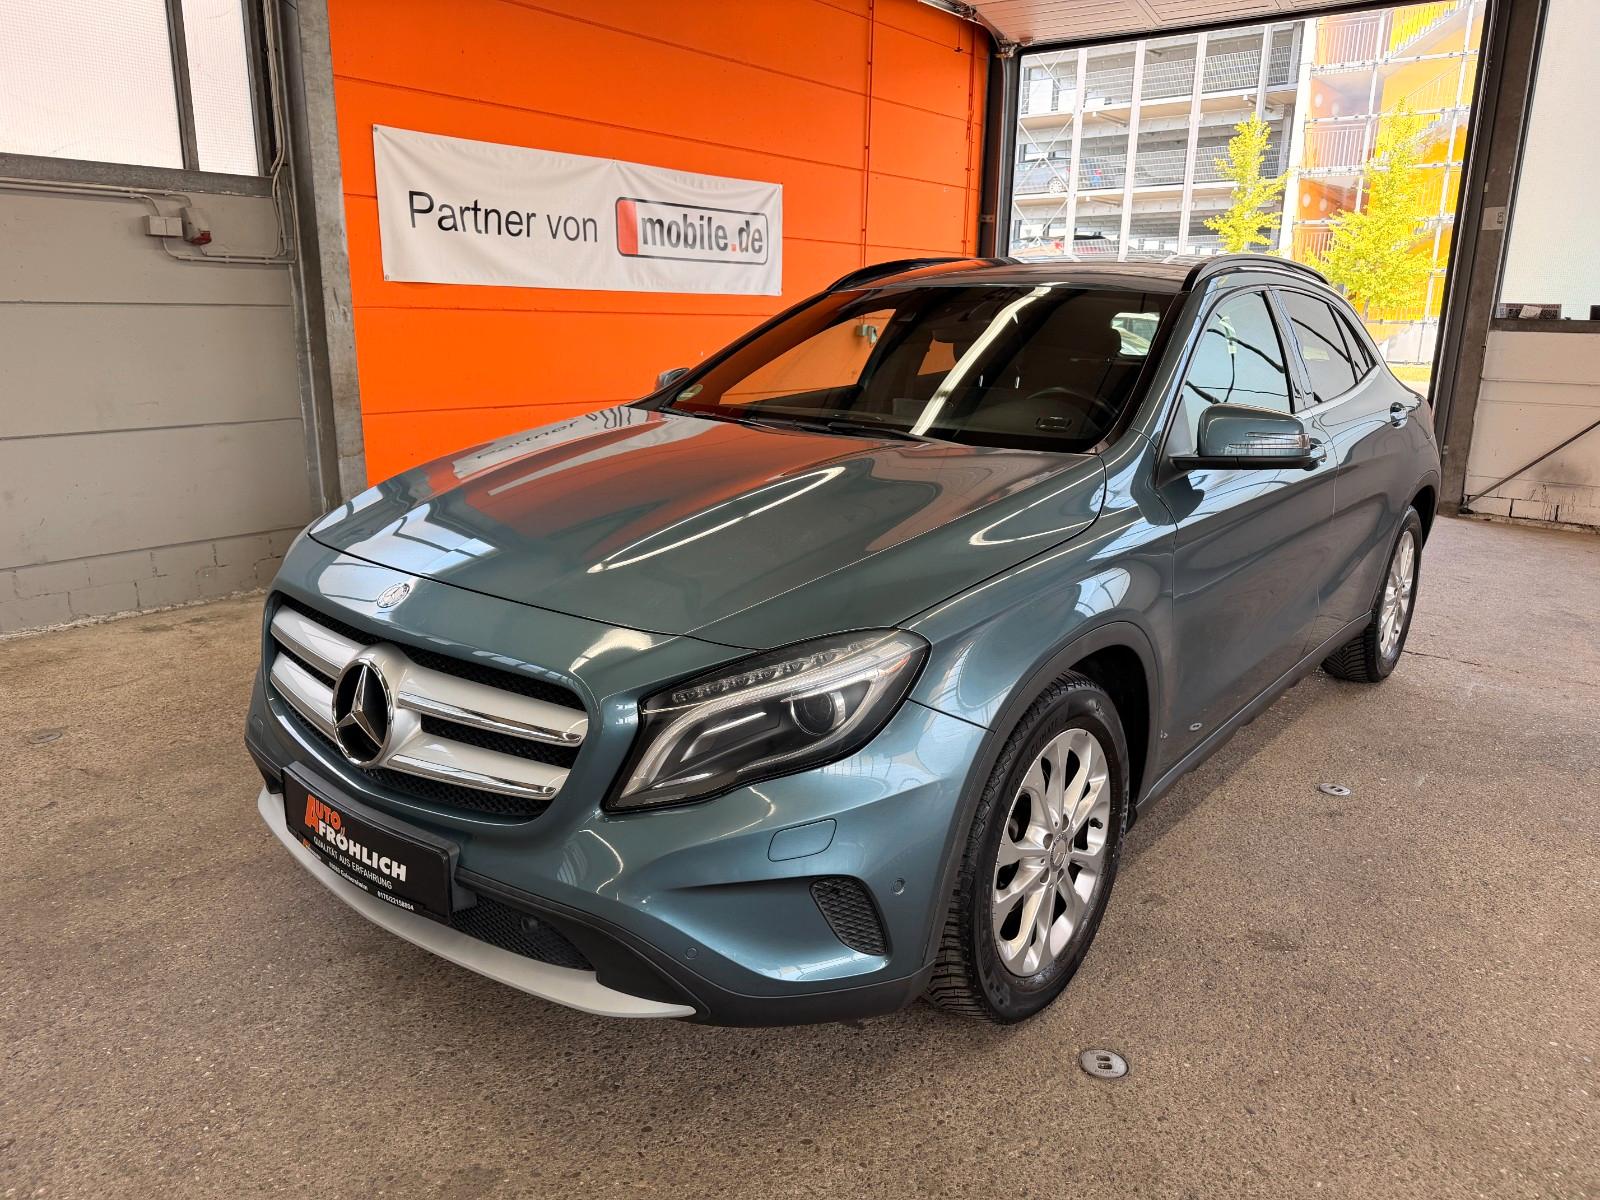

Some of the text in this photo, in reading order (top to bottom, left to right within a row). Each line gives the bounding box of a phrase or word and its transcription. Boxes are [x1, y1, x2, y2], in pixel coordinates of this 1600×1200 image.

[408, 190, 763, 255] Partner von mobile.de
[304, 793, 342, 833] AUTO
[318, 821, 407, 882] FRÖHLICH
[339, 852, 351, 867] AUS
[352, 863, 393, 890] ERFAHRUNG
